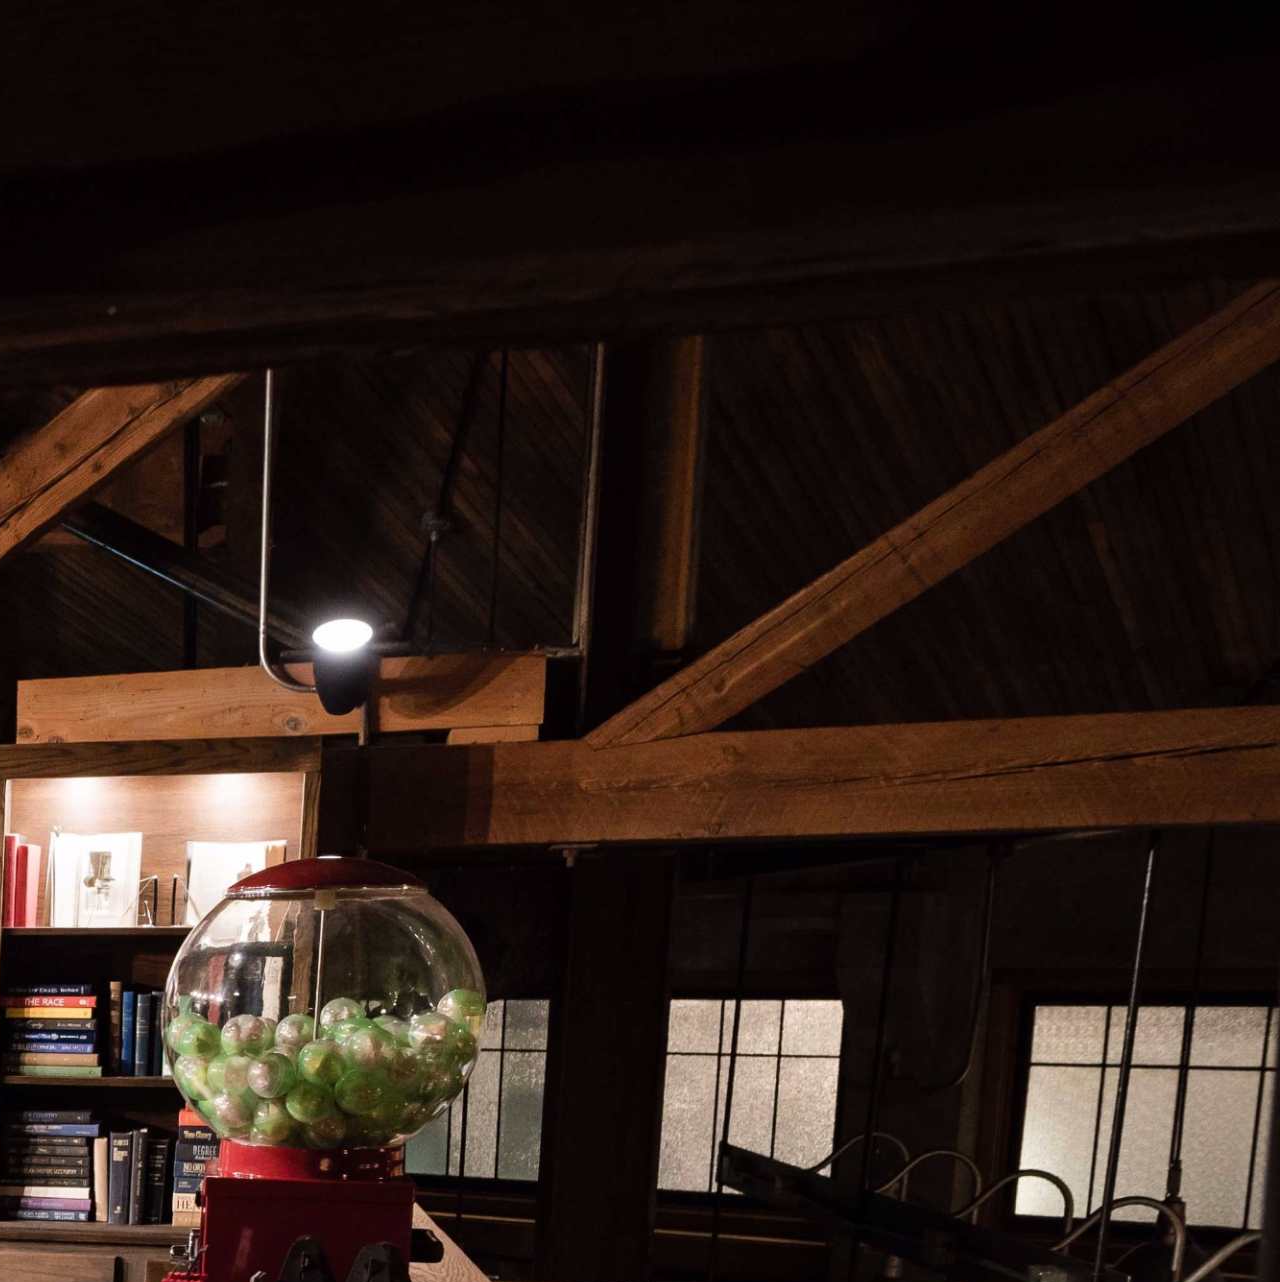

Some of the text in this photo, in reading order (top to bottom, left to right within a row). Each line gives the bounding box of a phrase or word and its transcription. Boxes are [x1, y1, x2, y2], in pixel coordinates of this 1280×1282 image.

[24, 998, 65, 1006] THE RACE
[183, 1130, 195, 1139] Tom
